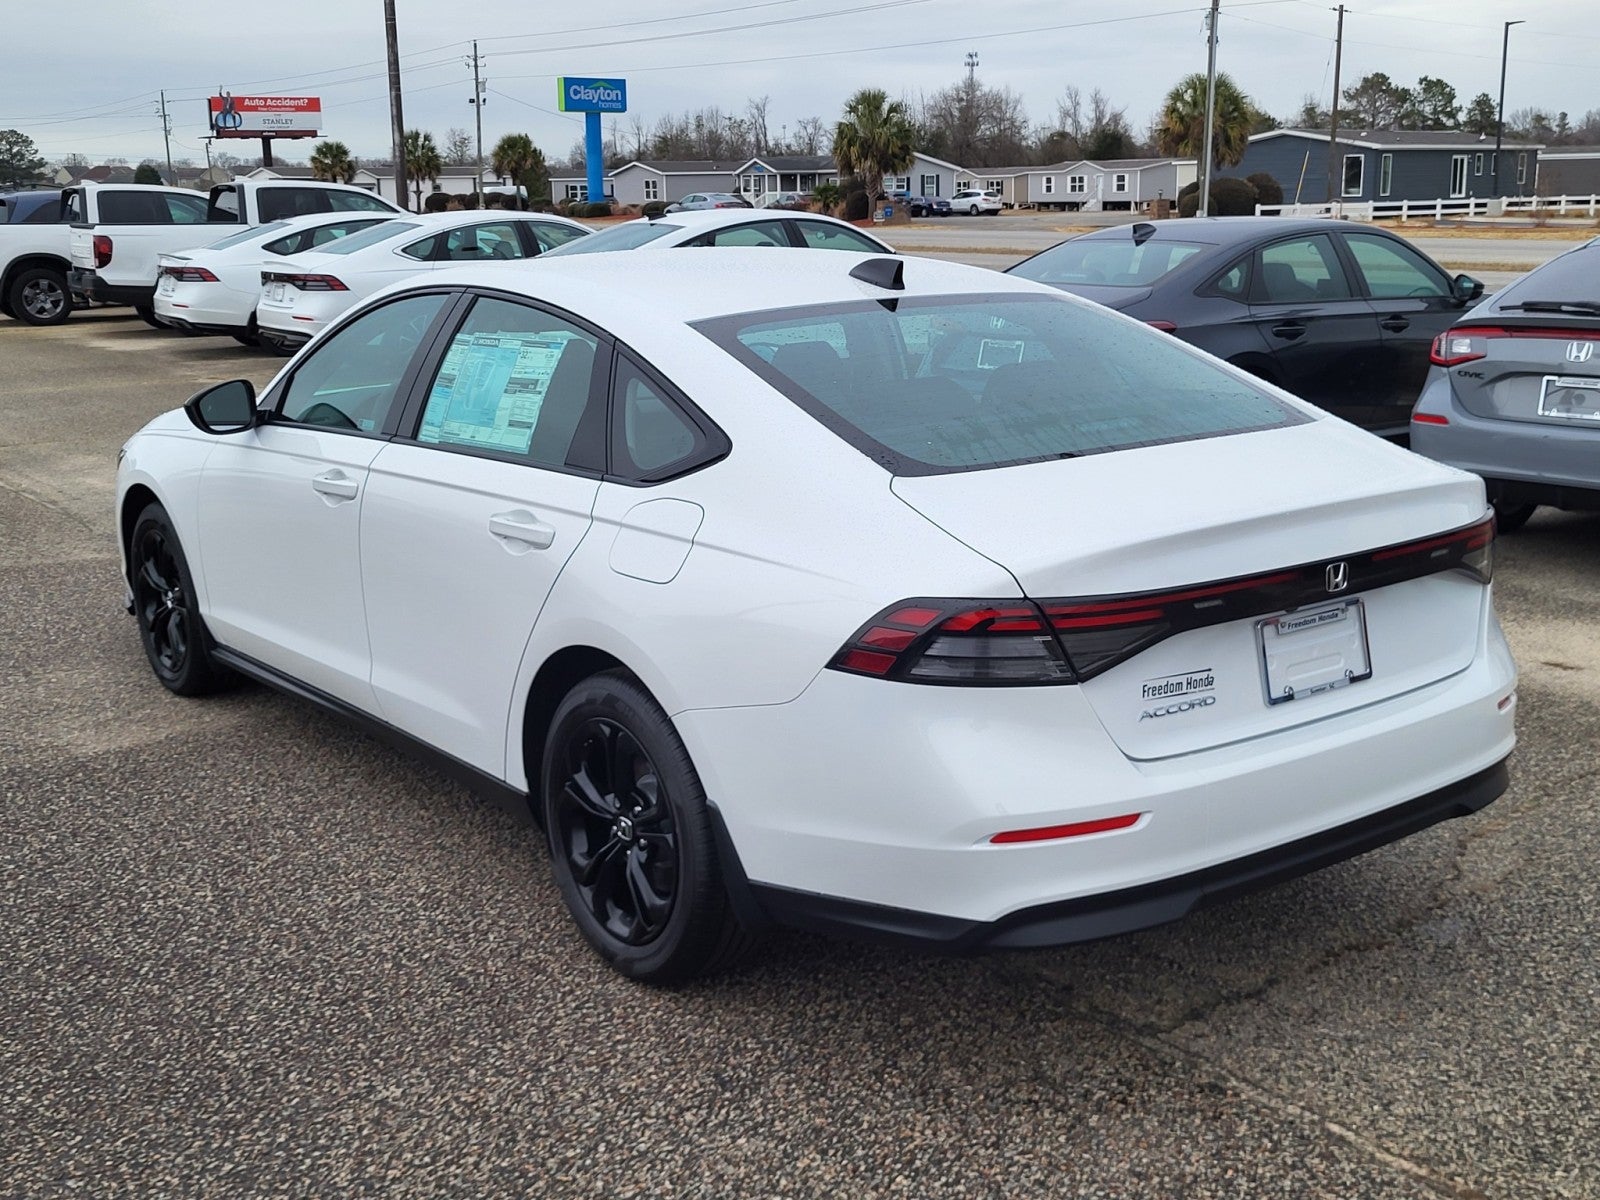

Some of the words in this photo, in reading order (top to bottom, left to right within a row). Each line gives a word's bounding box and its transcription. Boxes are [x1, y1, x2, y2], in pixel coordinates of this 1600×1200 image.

[243, 98, 265, 106] Auto
[266, 98, 308, 107] Accident?
[569, 84, 622, 104] Clayton
[598, 101, 622, 109] homes
[1457, 370, 1485, 380] CIVIC
[1287, 617, 1317, 630] Freedom
[1317, 611, 1339, 622] Honda
[1142, 680, 1184, 698] Freedom
[1185, 673, 1215, 690] Honda
[1139, 696, 1216, 722] ACCORD
